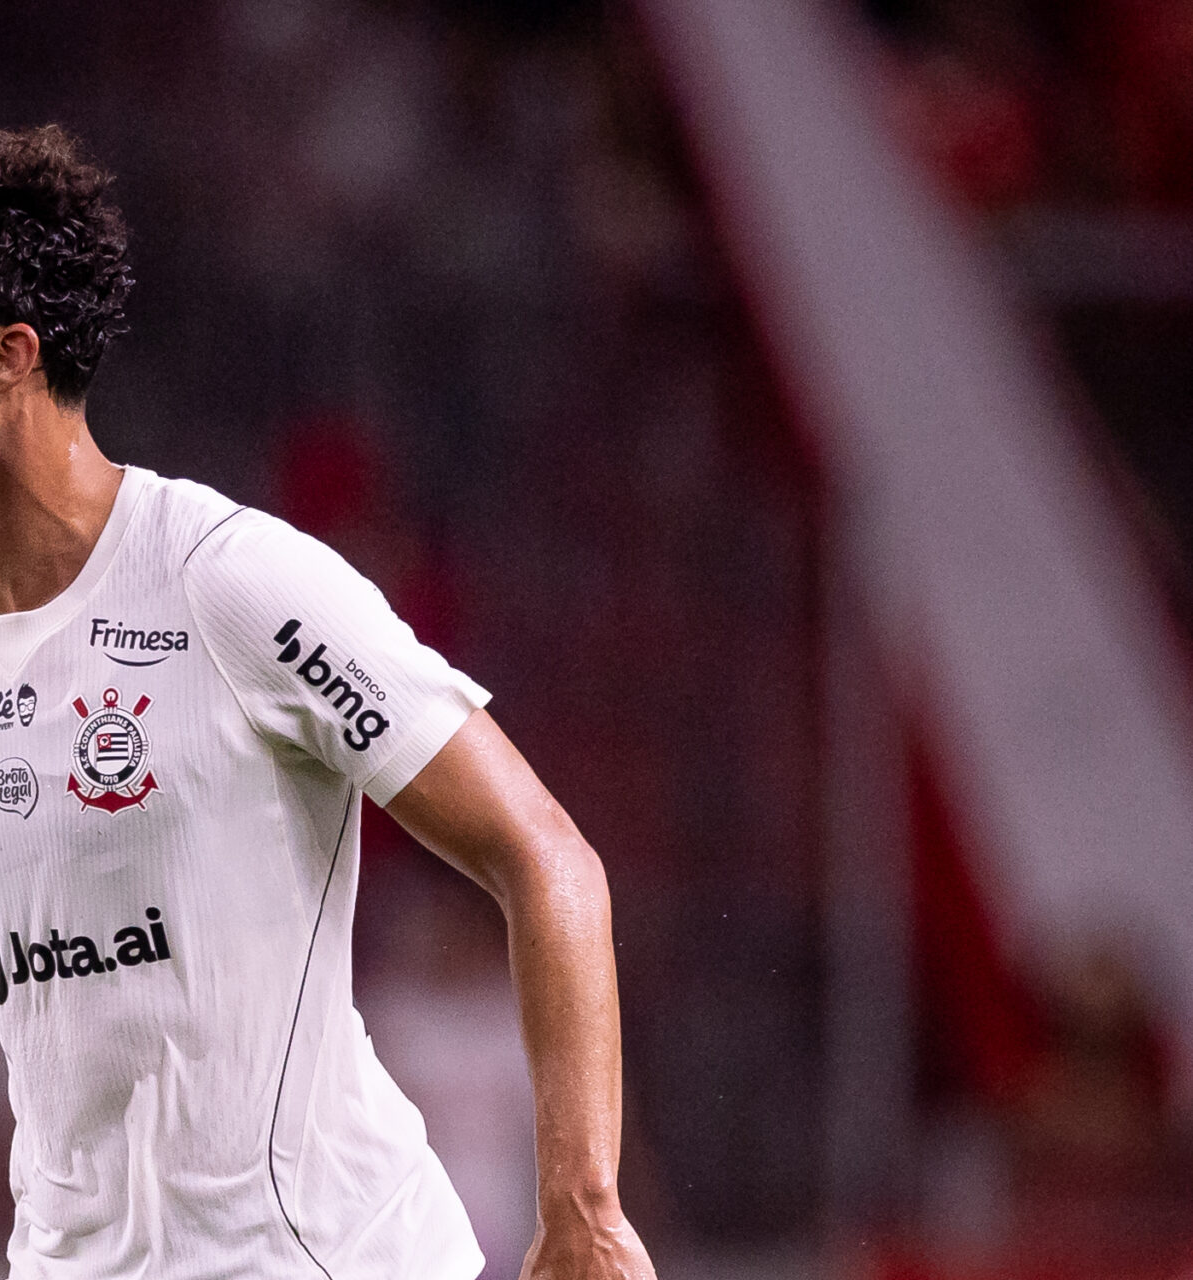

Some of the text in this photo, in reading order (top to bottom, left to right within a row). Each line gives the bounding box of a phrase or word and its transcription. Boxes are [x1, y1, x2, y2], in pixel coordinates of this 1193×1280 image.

[90, 618, 189, 651] Frimesa
[296, 643, 390, 752] bmg
[345, 658, 386, 702] banco
[81, 715, 129, 750] CORINTHIANS
[127, 725, 141, 768] PAULISTA
[0, 781, 32, 805] Legal
[100, 775, 119, 784] 1910
[10, 907, 171, 985] Jota.ai
